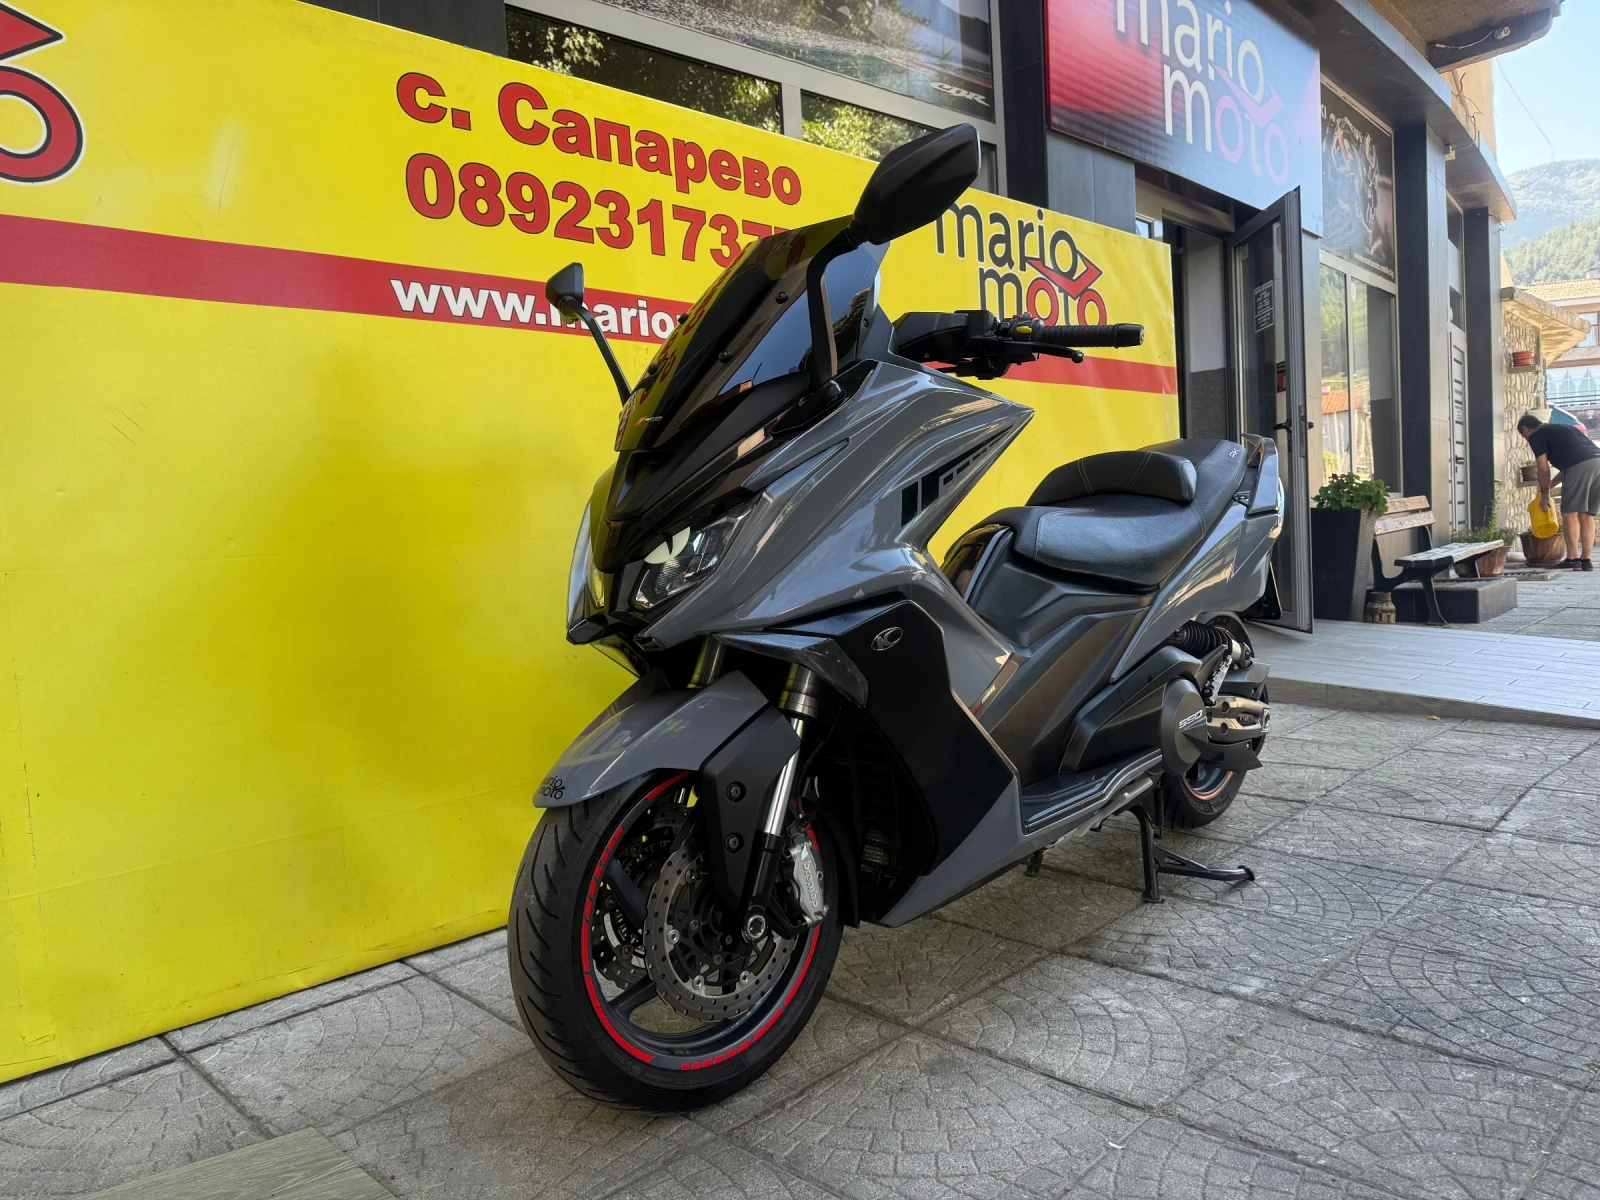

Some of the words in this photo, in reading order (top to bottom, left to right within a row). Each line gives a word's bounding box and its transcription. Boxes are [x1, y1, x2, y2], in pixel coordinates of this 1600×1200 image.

[497, 82, 802, 205] Сапарево
[1163, 64, 1289, 187] moto
[935, 202, 1079, 280] mario
[389, 278, 684, 341] www.ario
[978, 266, 1108, 327] moto
